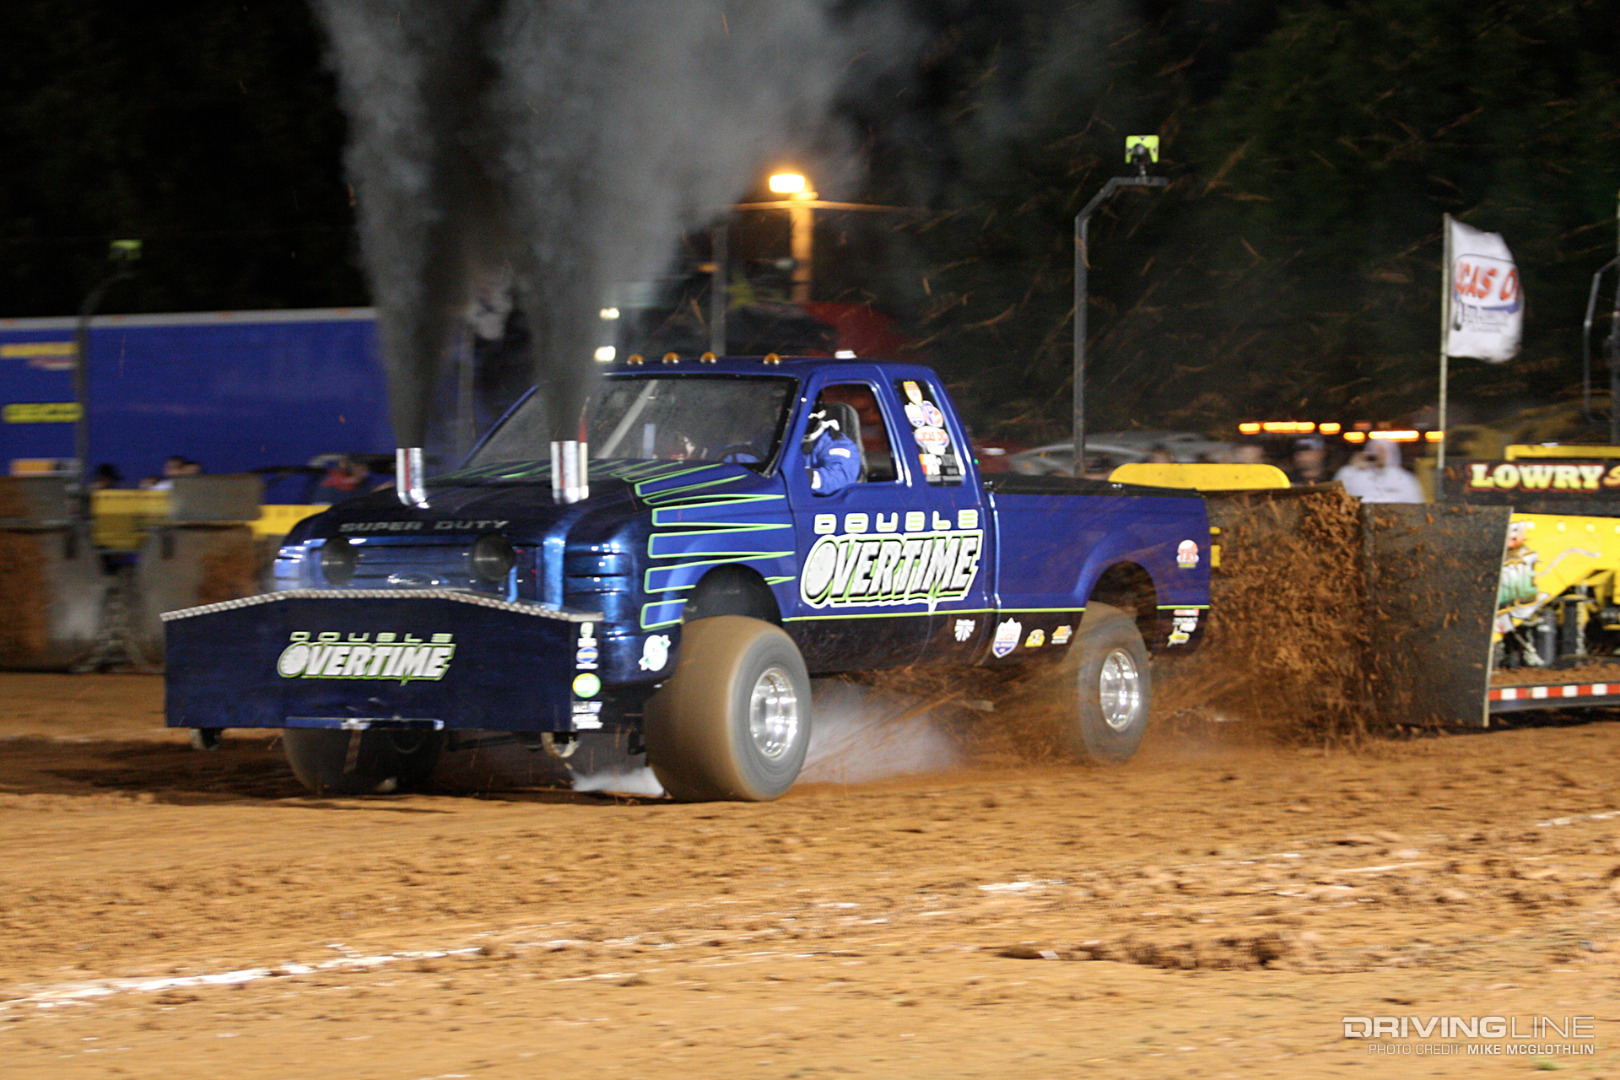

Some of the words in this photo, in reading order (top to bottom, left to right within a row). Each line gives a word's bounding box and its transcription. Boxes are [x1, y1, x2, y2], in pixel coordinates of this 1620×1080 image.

[1469, 464, 1605, 490] LOWRY
[339, 520, 424, 533] SUPER
[434, 519, 510, 531] DUTY
[814, 509, 979, 535] DOUBLE
[802, 530, 983, 609] OVERTIME
[289, 631, 454, 643] DOUBLE
[278, 642, 457, 682] OVERTIME
